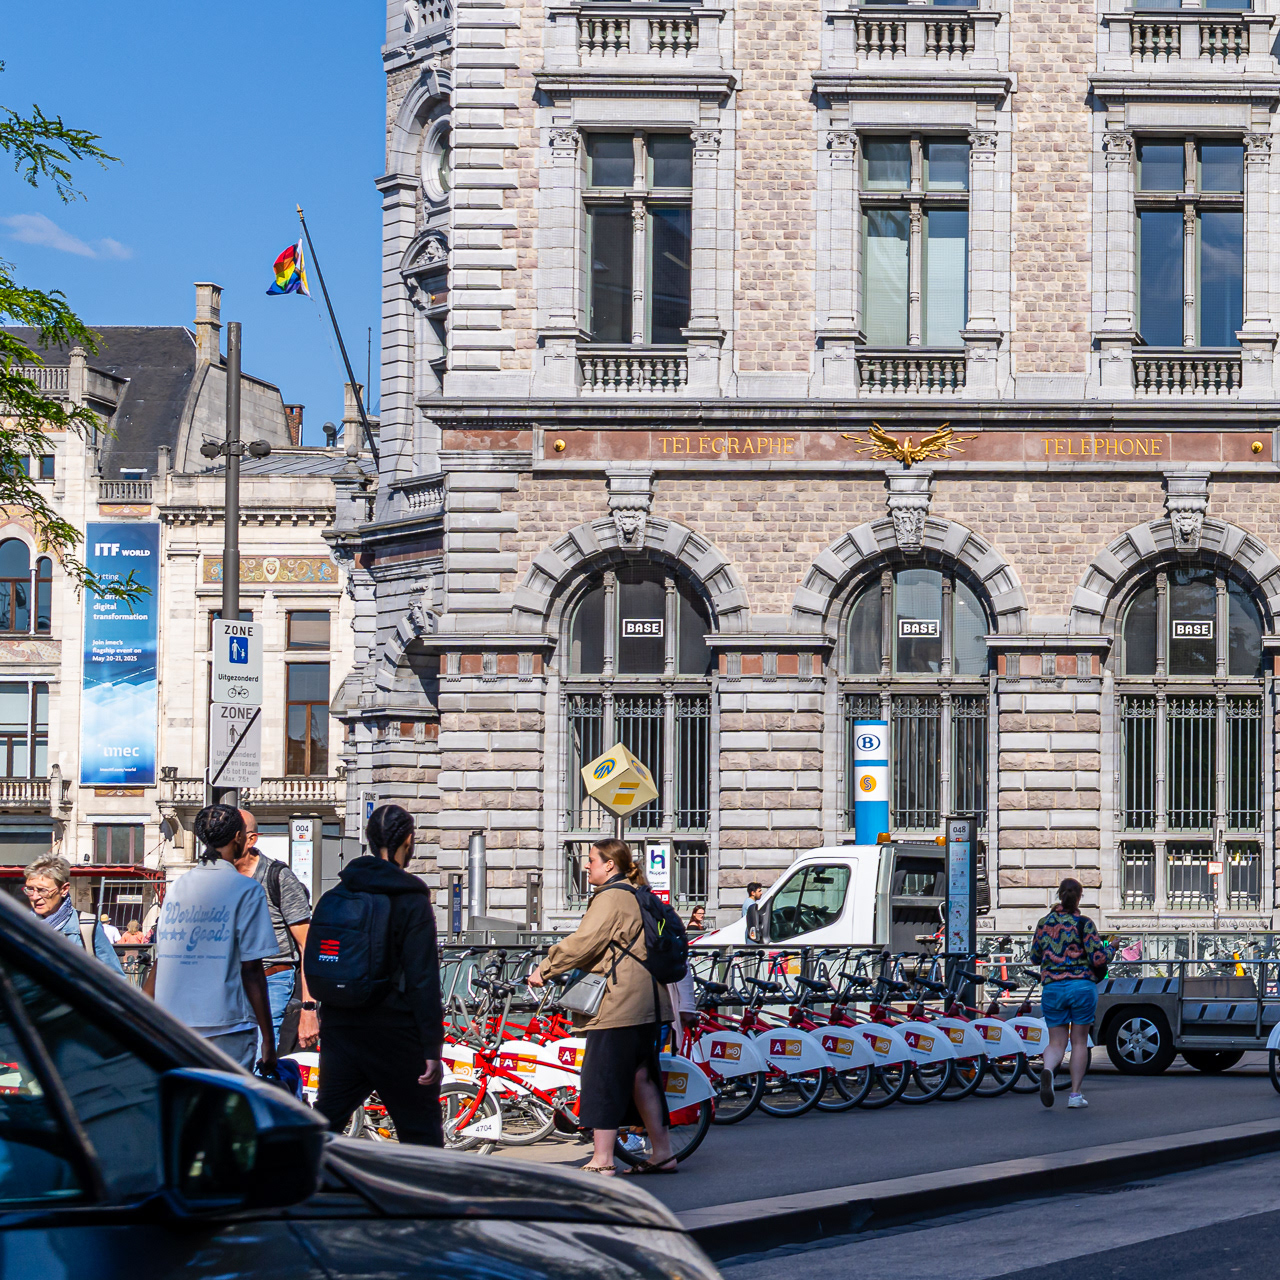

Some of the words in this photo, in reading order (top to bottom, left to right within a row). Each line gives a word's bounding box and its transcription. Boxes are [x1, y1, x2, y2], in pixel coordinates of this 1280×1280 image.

[658, 434, 795, 455] TÉLÉGRAPHE
[1041, 435, 1163, 456] TÉLÉPHONE
[94, 543, 121, 556] ITF
[93, 602, 117, 611] digital
[224, 624, 254, 637] ZONE
[626, 623, 660, 635] BASE
[903, 623, 937, 635] BASE
[1176, 624, 1210, 636] BASE
[218, 673, 259, 682] Uitgezonderd
[221, 706, 253, 720] ZONE
[364, 792, 377, 801] ZONE
[295, 825, 309, 833] 004
[953, 825, 966, 834] 048
[164, 901, 231, 925] Worldwide
[186, 923, 231, 952] Goods
[714, 1045, 722, 1055] A
[774, 1042, 782, 1052] A
[562, 1050, 572, 1062] A
[475, 1124, 492, 1132] 4704
